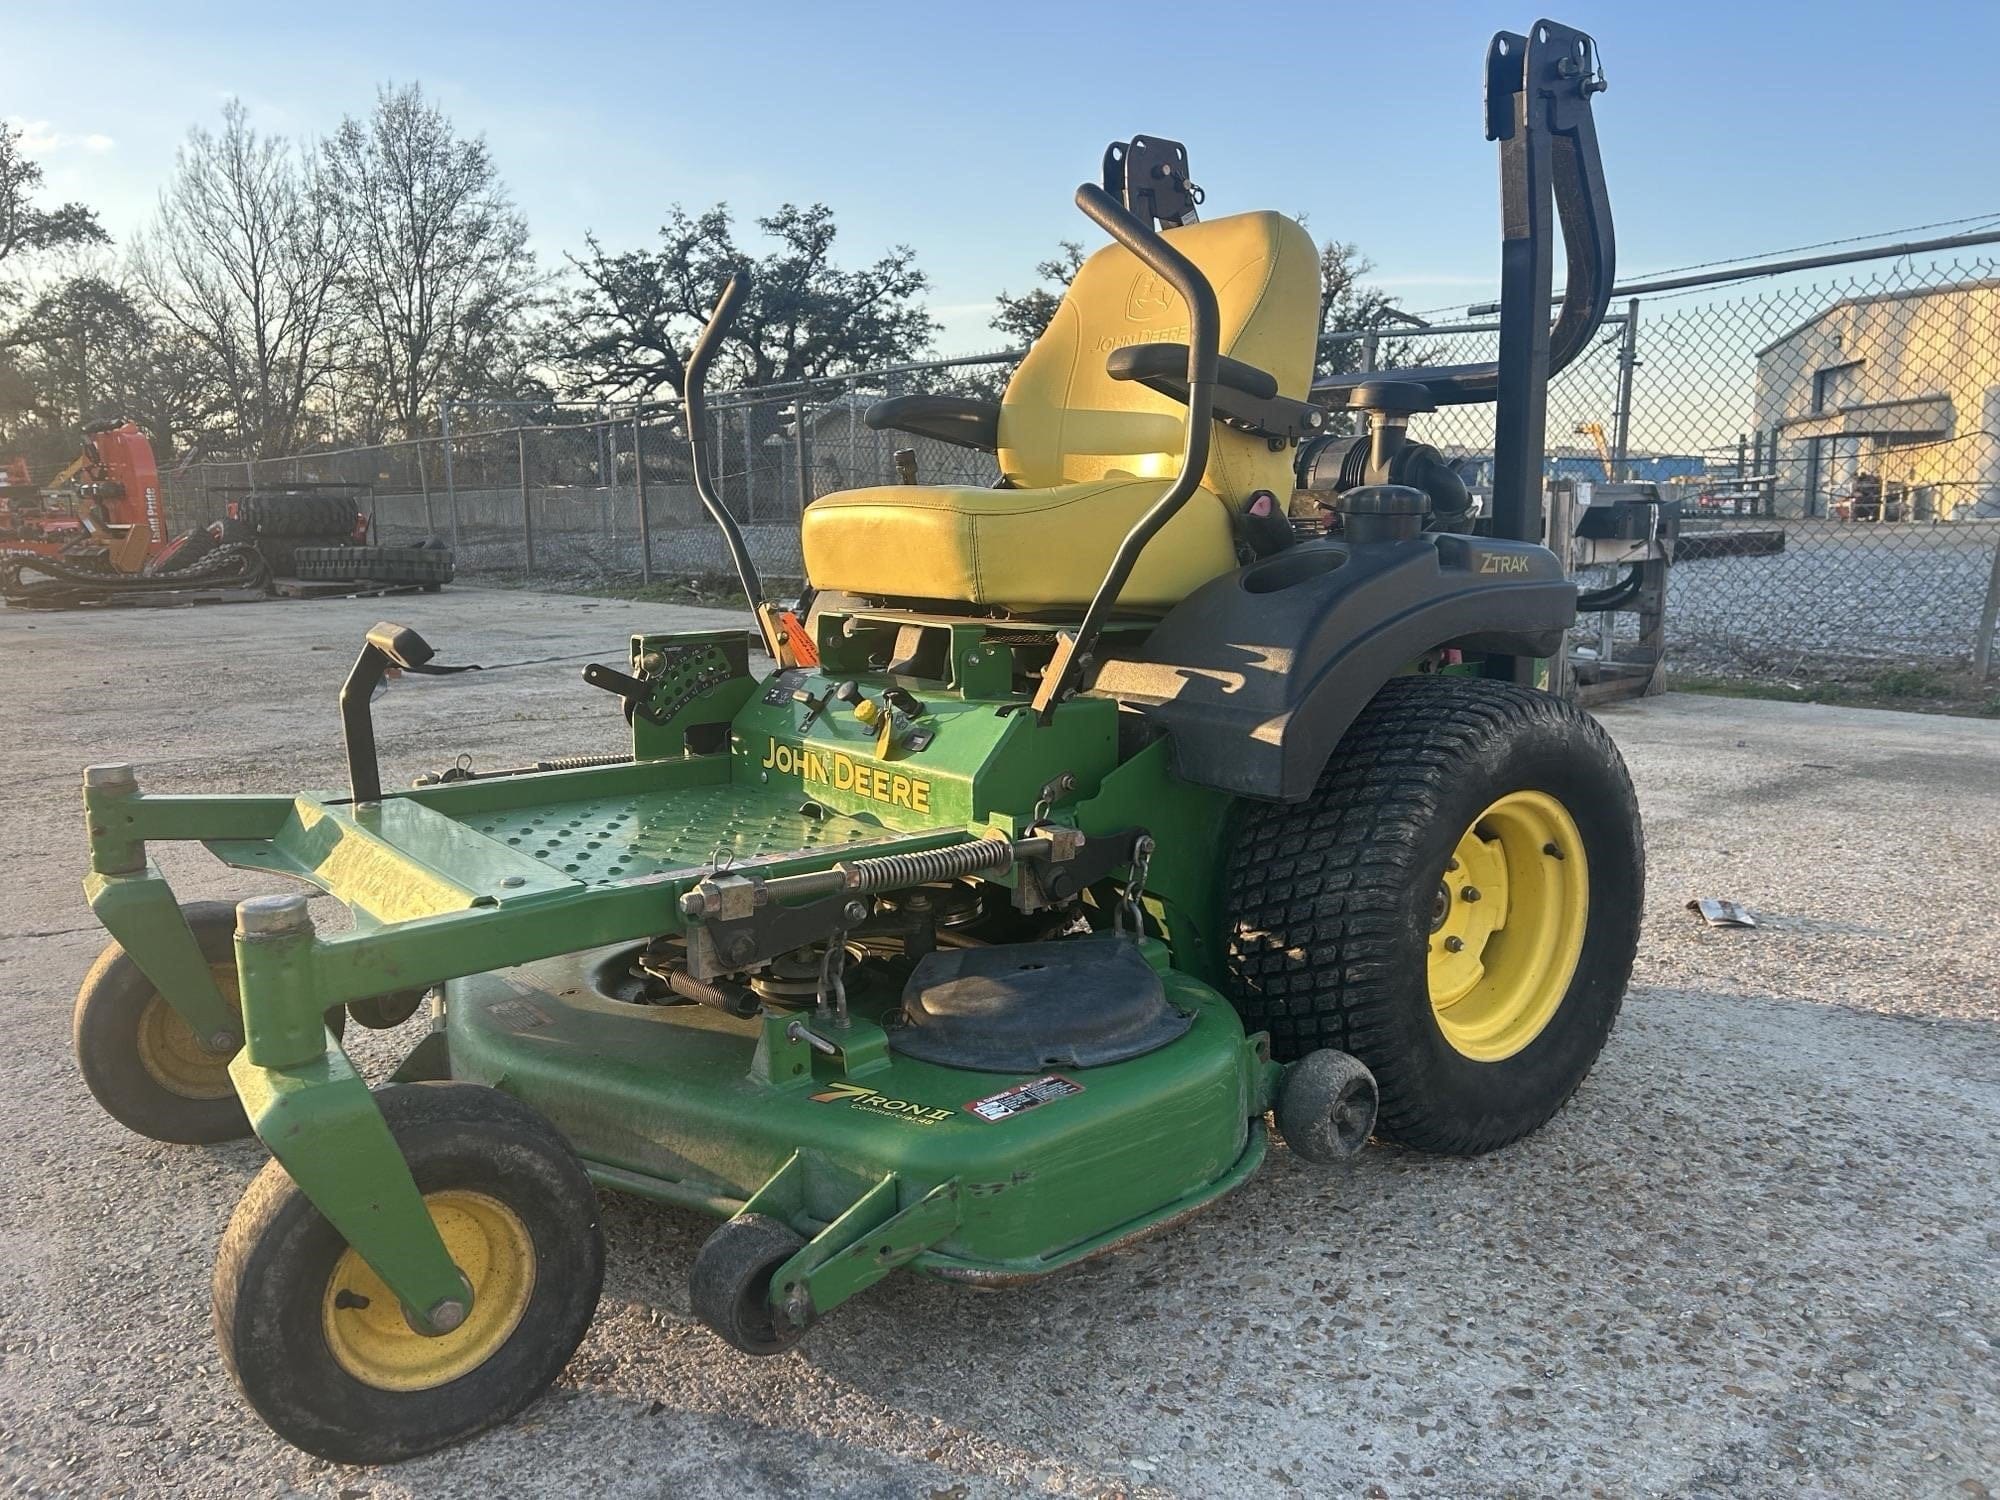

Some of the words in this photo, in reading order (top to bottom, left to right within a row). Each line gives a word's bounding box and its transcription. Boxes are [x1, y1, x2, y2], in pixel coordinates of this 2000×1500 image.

[1138, 325, 1188, 345] DEERE
[149, 516, 161, 543] Land
[762, 736, 829, 785] JOHN
[833, 752, 931, 815] DEERE
